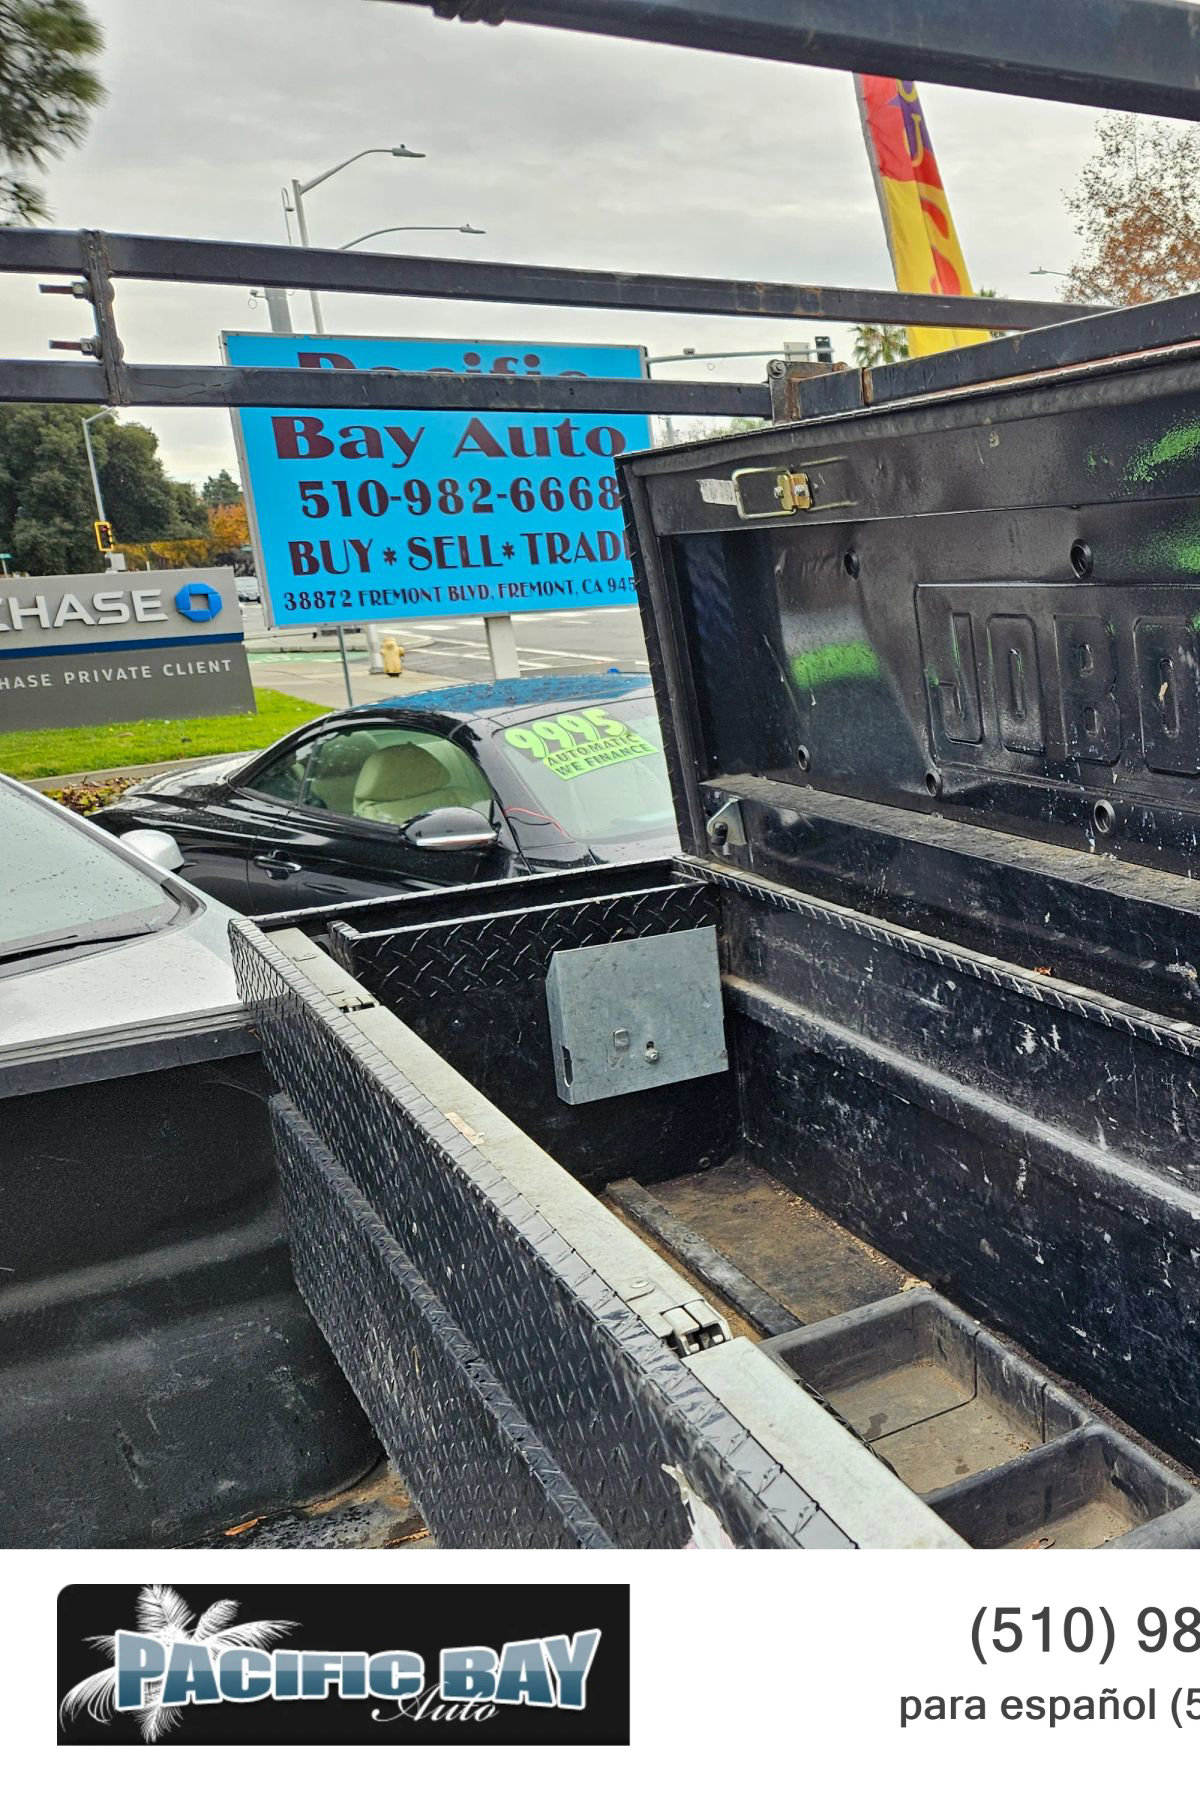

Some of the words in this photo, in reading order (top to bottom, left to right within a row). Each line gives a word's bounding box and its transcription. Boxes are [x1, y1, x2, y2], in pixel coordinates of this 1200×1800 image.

[271, 415, 425, 468] Bay
[453, 417, 627, 459] Auto
[298, 475, 622, 519] 510-982-6668
[288, 538, 373, 576] BUY
[407, 534, 503, 571] SELL
[0, 589, 169, 632] HASE
[284, 589, 352, 611] 38872
[358, 586, 442, 607] FREMONT
[582, 579, 603, 595] CA
[607, 577, 637, 593] 945
[0, 673, 53, 691] HASE
[64, 665, 153, 685] PRIVATE
[162, 658, 232, 677] CLIENT
[504, 707, 629, 759] 9995
[547, 732, 641, 767] AUTOMATIC
[555, 761, 584, 777] WE
[586, 742, 652, 768] FINANCE
